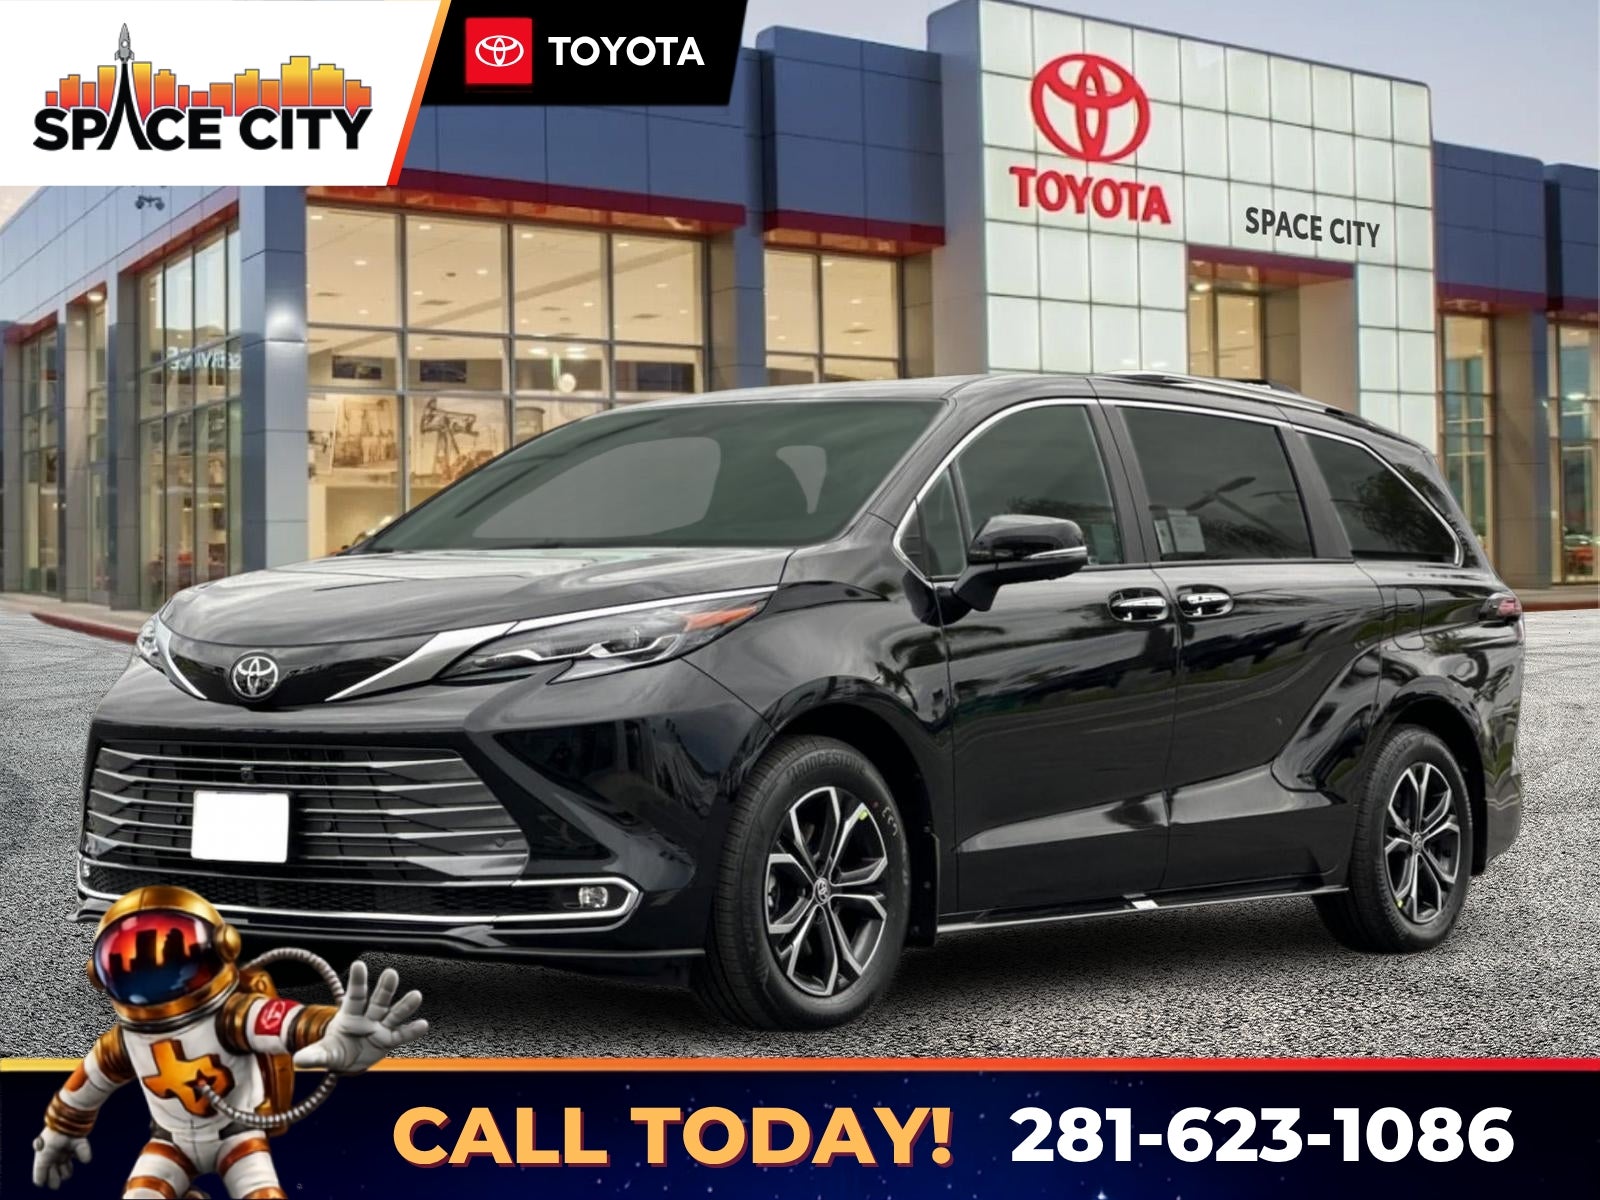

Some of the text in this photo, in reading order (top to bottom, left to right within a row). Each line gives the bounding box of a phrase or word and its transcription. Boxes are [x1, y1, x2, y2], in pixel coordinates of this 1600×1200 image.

[1010, 166, 1171, 224] TOYOTA
[1245, 206, 1381, 248] SPACE CITY
